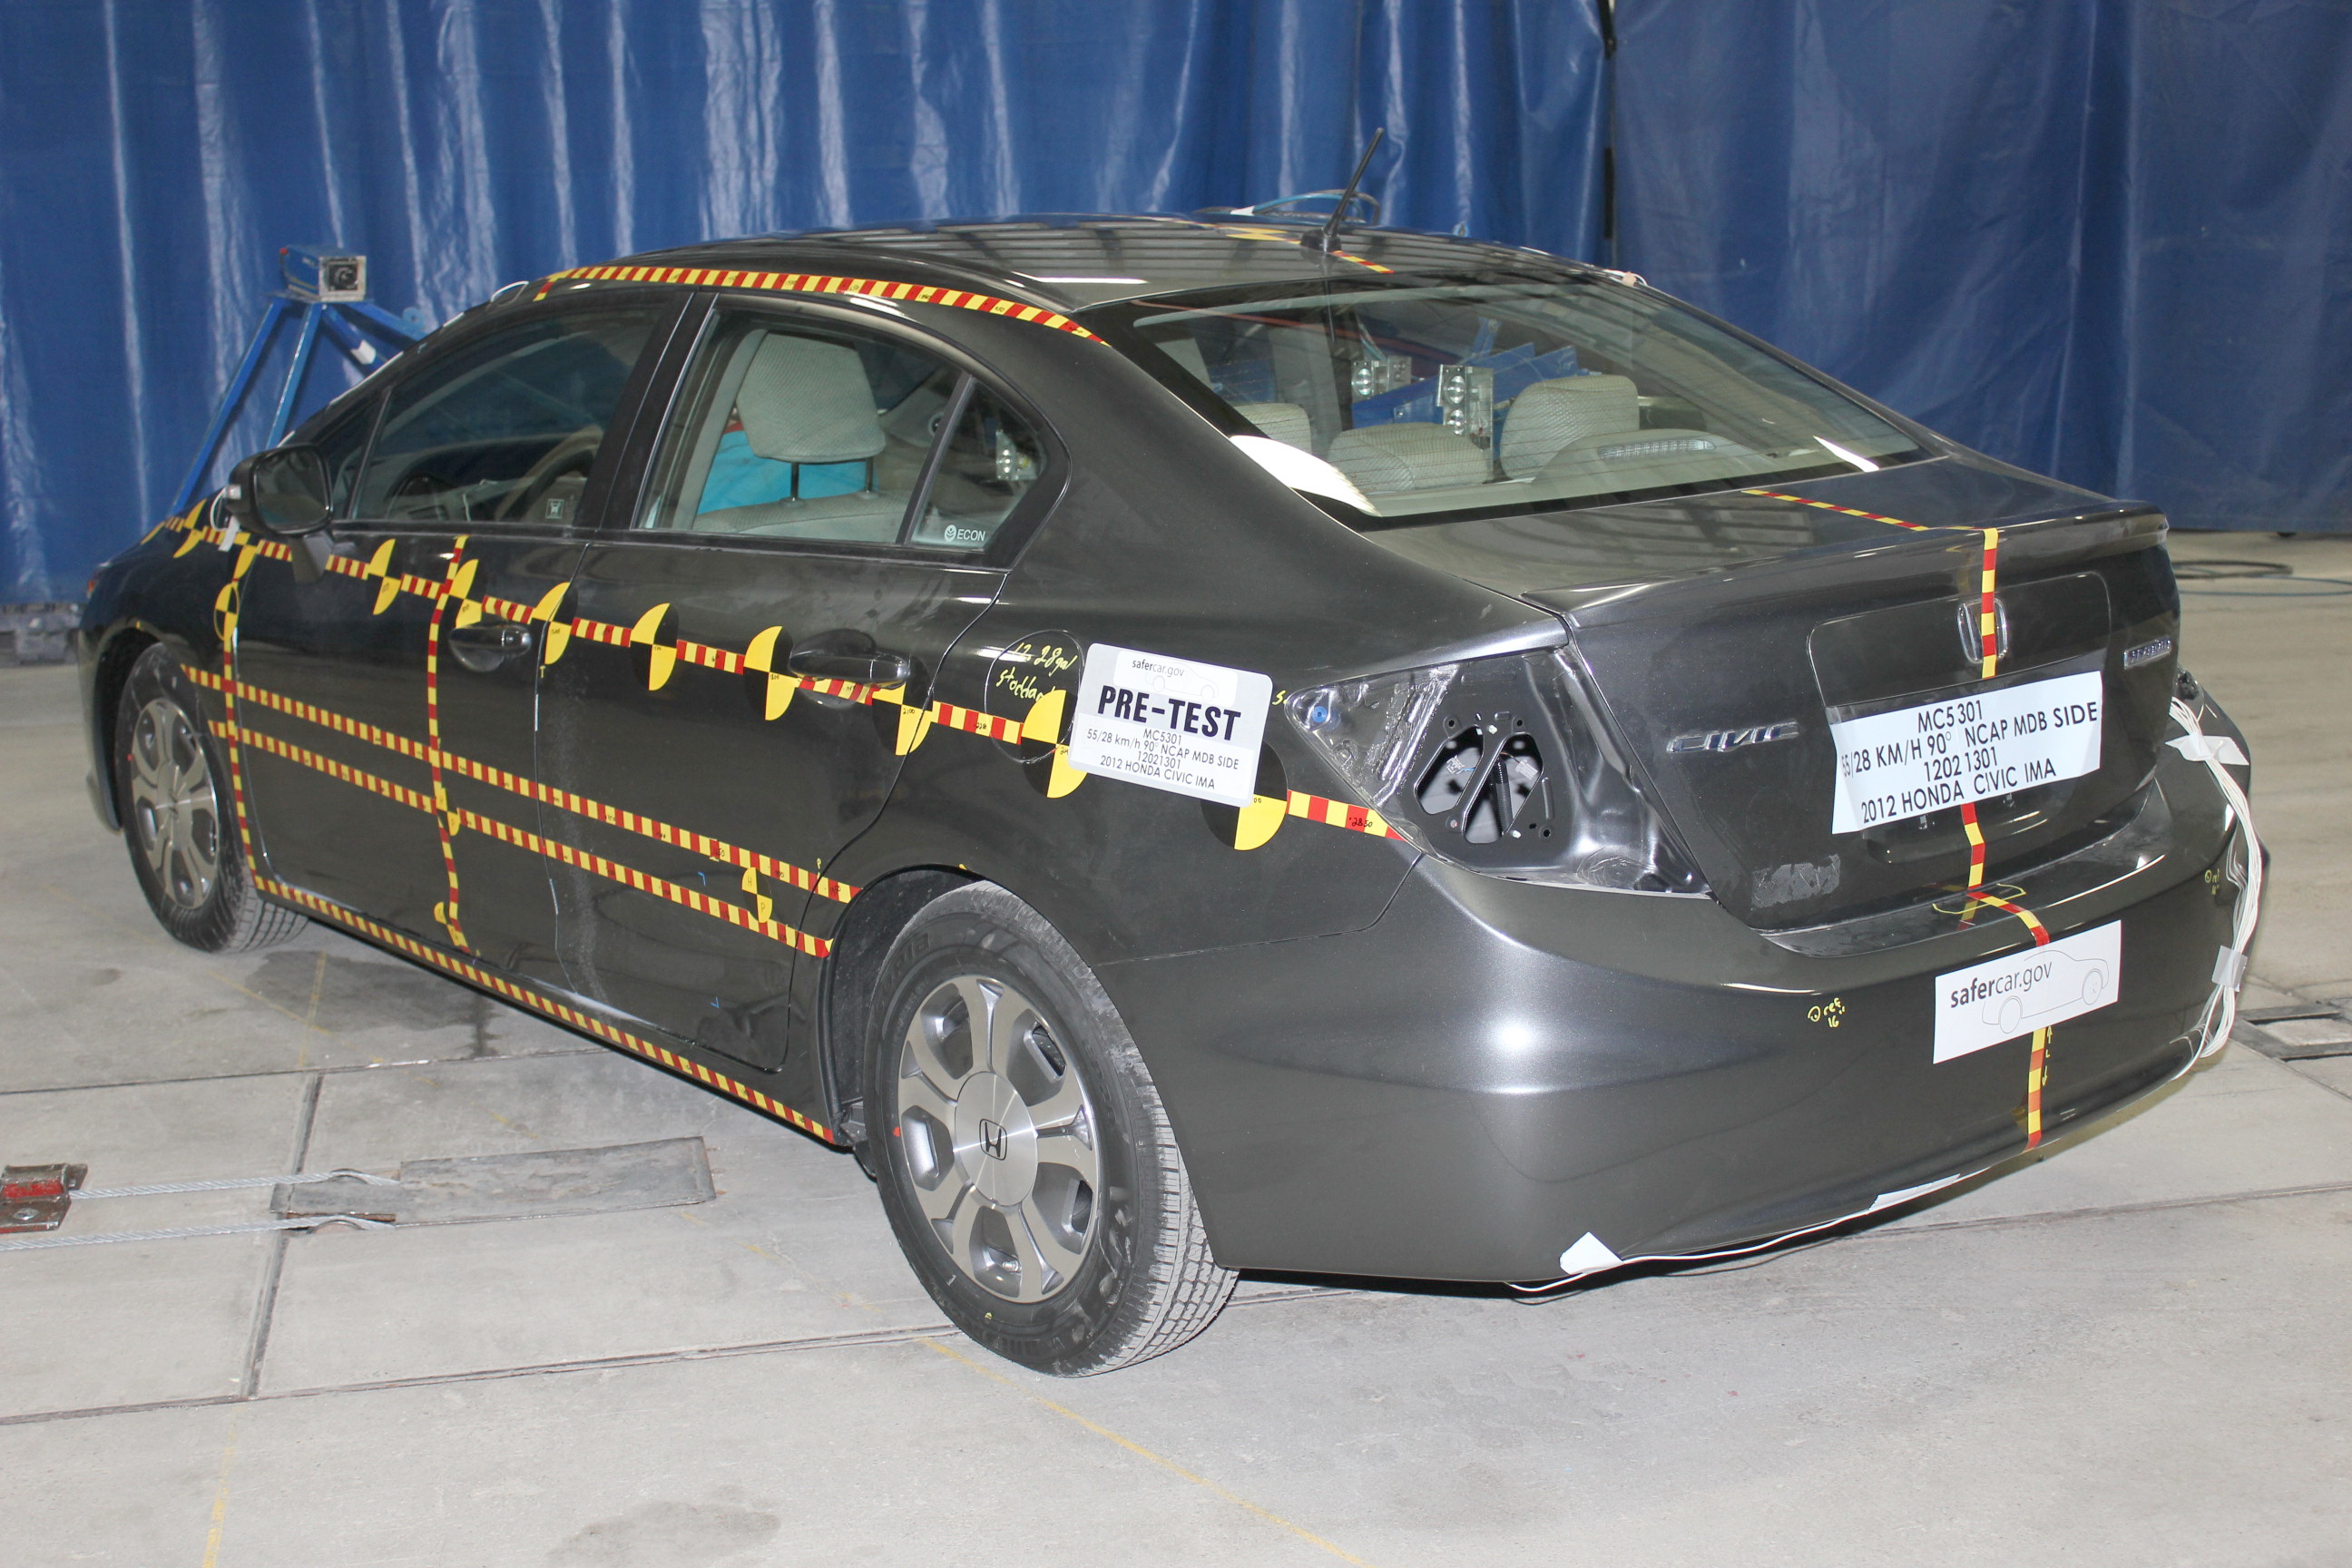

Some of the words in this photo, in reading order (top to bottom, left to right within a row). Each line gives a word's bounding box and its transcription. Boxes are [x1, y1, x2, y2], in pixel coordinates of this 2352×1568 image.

[956, 529, 985, 542] ECON
[1132, 659, 1185, 678] safercar.gov
[1097, 685, 1242, 741] PRE-TEST
[1917, 700, 1983, 733] MC5301
[1086, 728, 1112, 744] 55/28
[1115, 734, 1141, 750] km/h
[1161, 743, 1190, 759] NCAP
[1191, 750, 1214, 765] MDB
[1217, 755, 1240, 770] SIDE
[1142, 728, 1181, 746] MC5301
[1876, 738, 1922, 766] KM/H
[1965, 719, 2008, 748] NCAP
[2014, 710, 2047, 737] MDB
[2053, 701, 2098, 728] SIDE
[1100, 754, 1122, 769] 2012
[1125, 761, 1161, 778] HONDA
[1163, 769, 1192, 784] CIVIC
[1195, 776, 1215, 789] IMA
[1137, 750, 1181, 769] 12021301
[1861, 795, 1896, 824] 2012
[1901, 779, 1965, 814] HONDA
[1974, 766, 2017, 795] CIVIC
[2024, 758, 2056, 783] IMA
[1950, 960, 2053, 1008] safercar.gov
